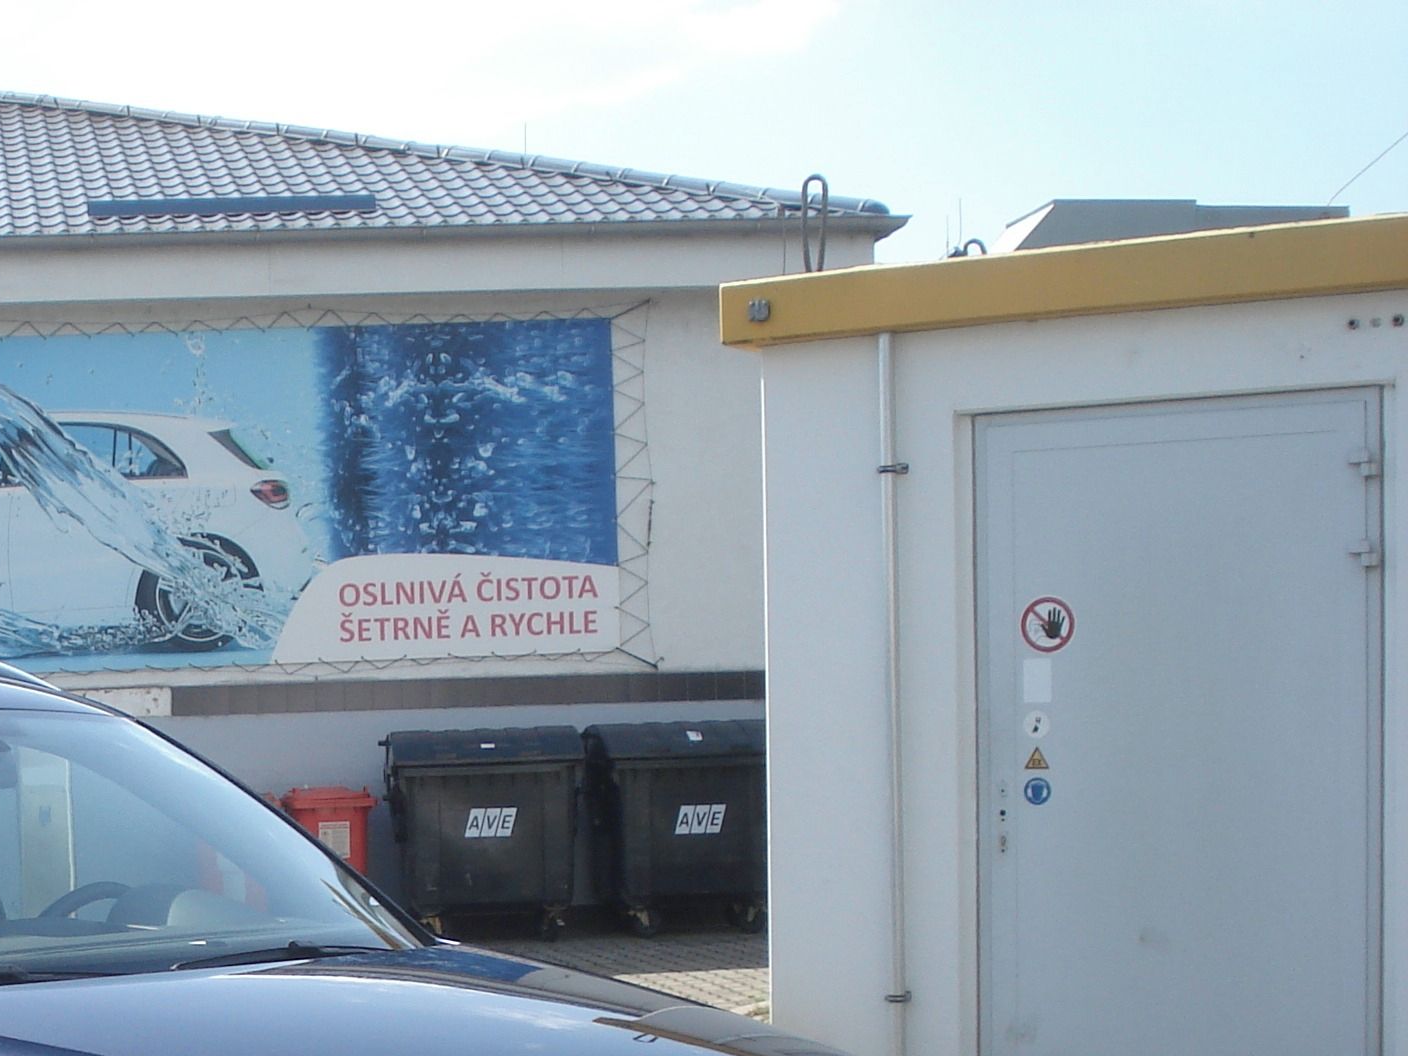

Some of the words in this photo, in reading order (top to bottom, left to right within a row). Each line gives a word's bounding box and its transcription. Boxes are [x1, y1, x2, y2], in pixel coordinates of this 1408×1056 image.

[339, 573, 467, 607] OSLNIVÁ
[476, 572, 598, 602] ČISTOTA
[339, 609, 451, 643] ŠETRNĚ
[460, 615, 480, 638] A
[491, 611, 598, 637] RYCHLE
